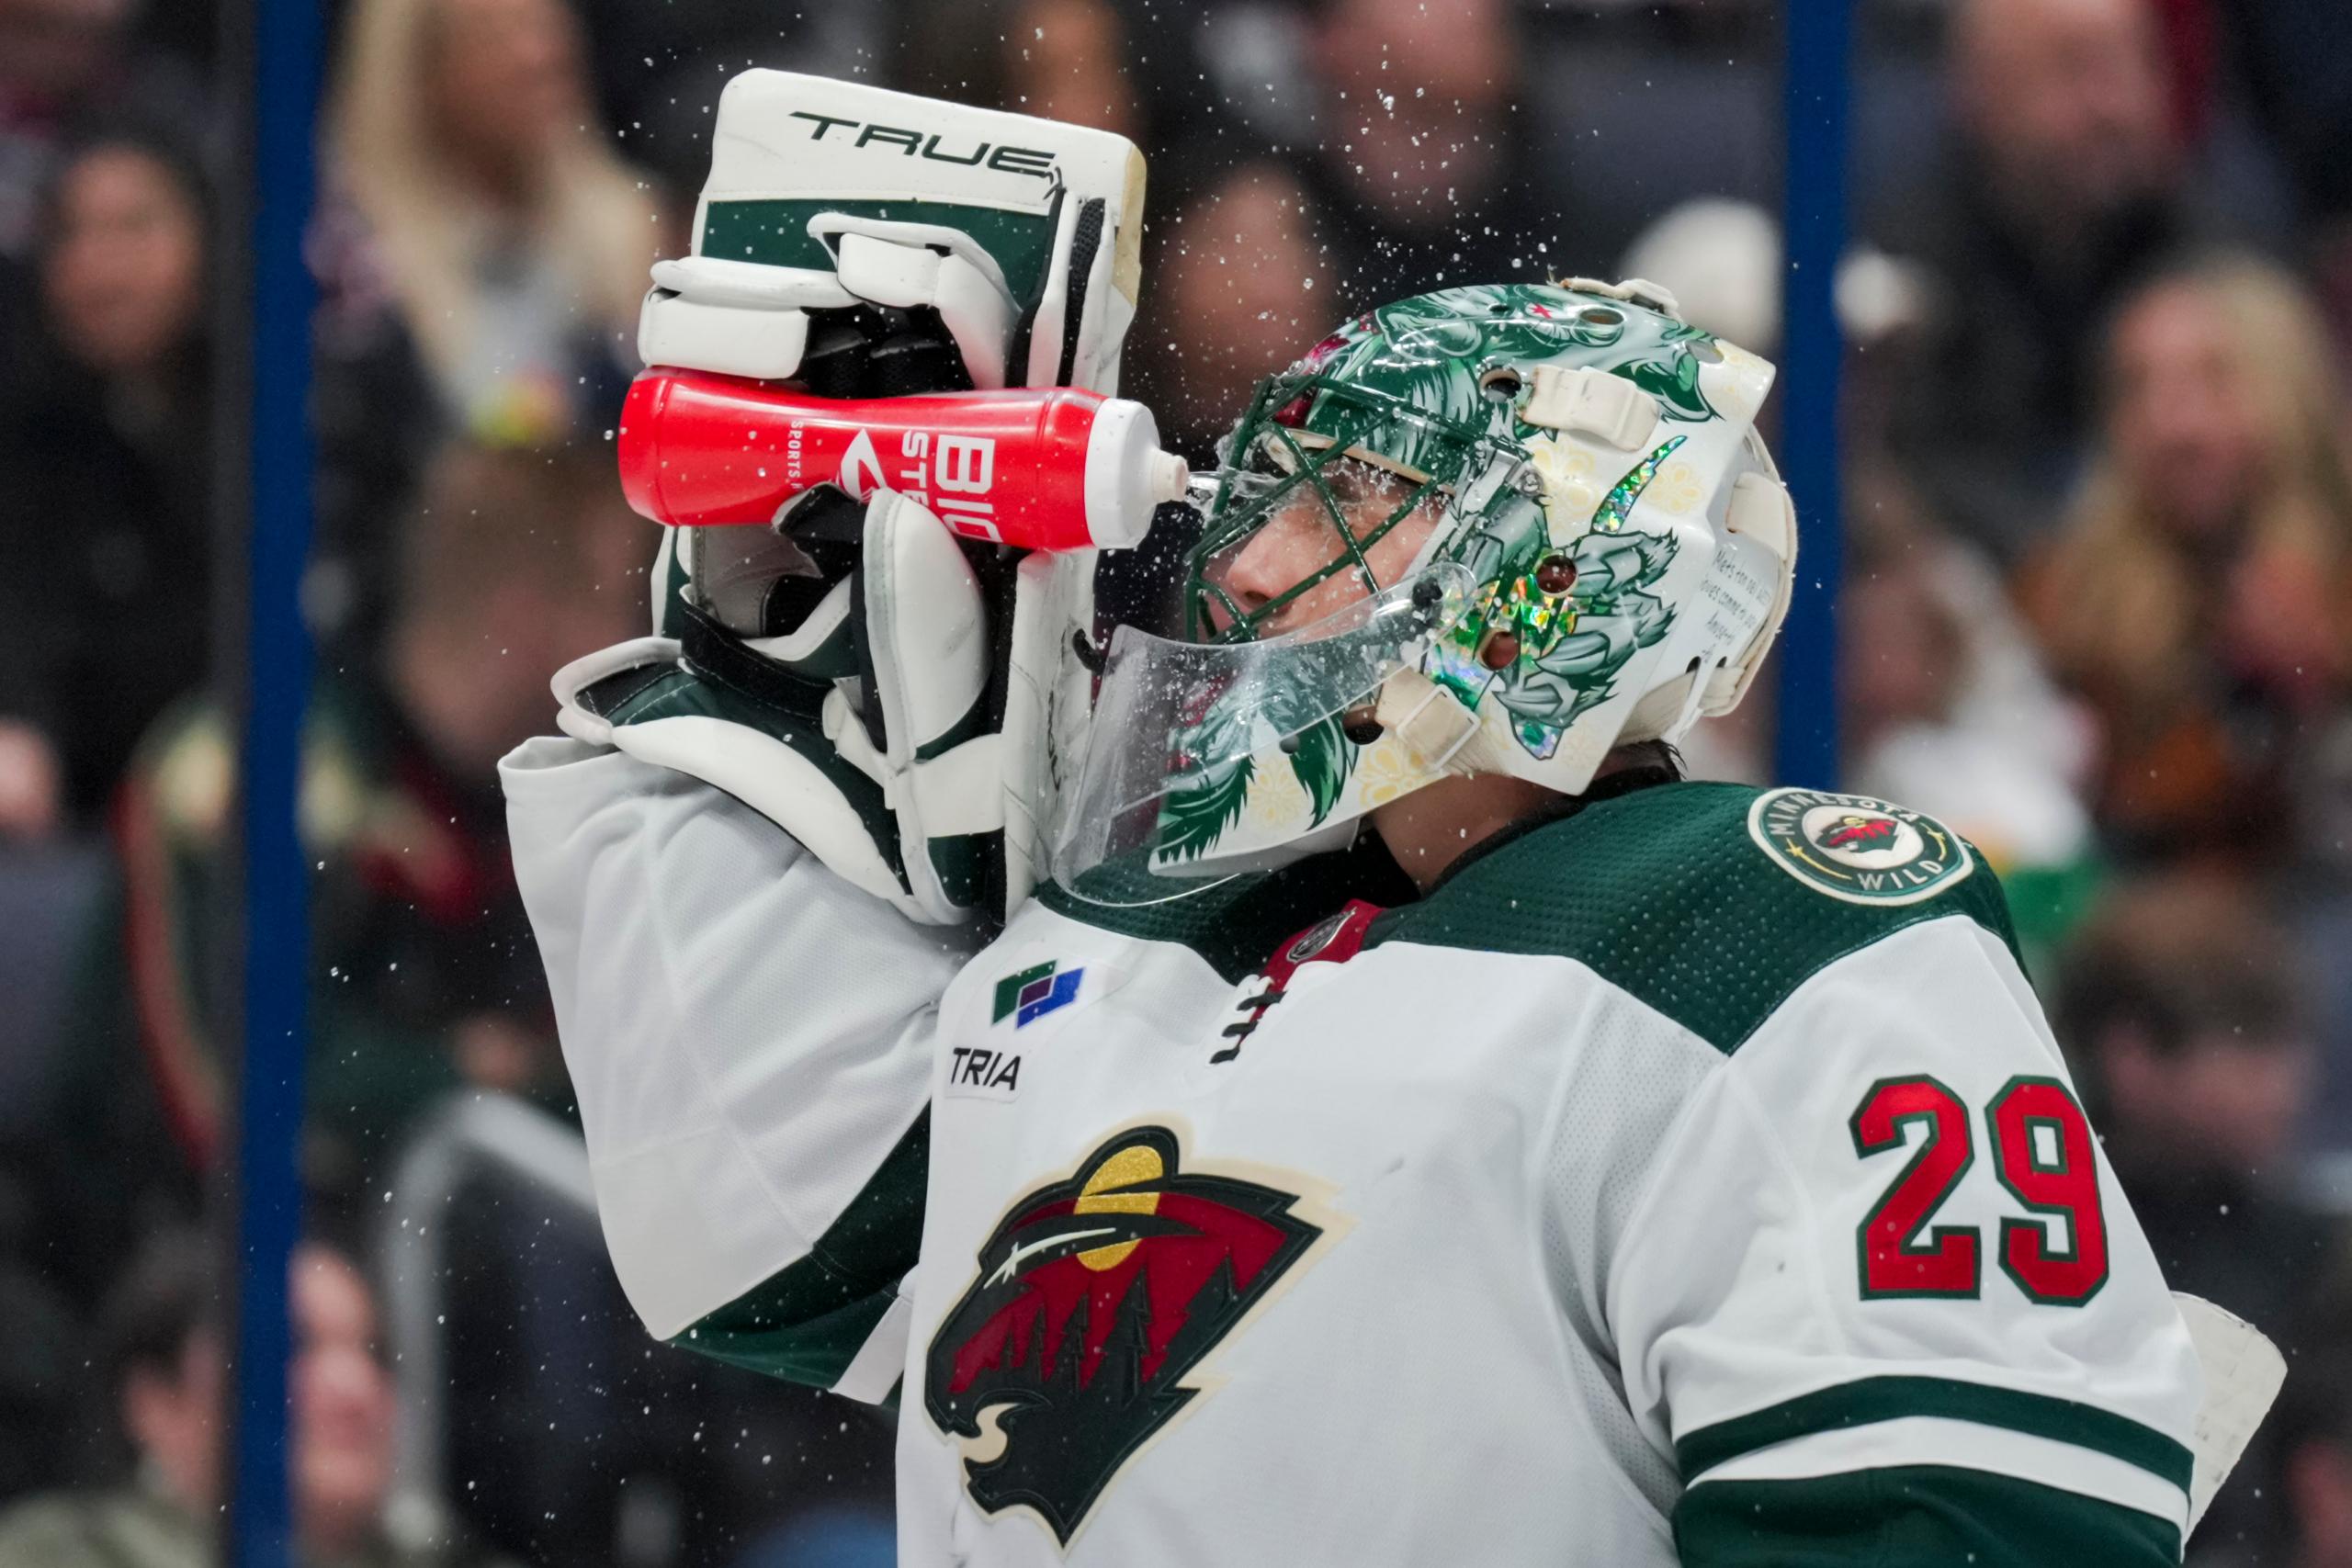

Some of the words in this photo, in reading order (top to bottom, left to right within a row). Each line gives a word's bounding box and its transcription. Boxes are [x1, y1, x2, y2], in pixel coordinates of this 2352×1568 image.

[788, 111, 1057, 177] TRUE
[787, 420, 804, 479] SPORTS
[1768, 793, 1920, 836] MINNESOTA
[1858, 860, 1944, 891] WILD
[951, 1047, 1022, 1091] TRIA
[1848, 1073, 2109, 1308] 29
